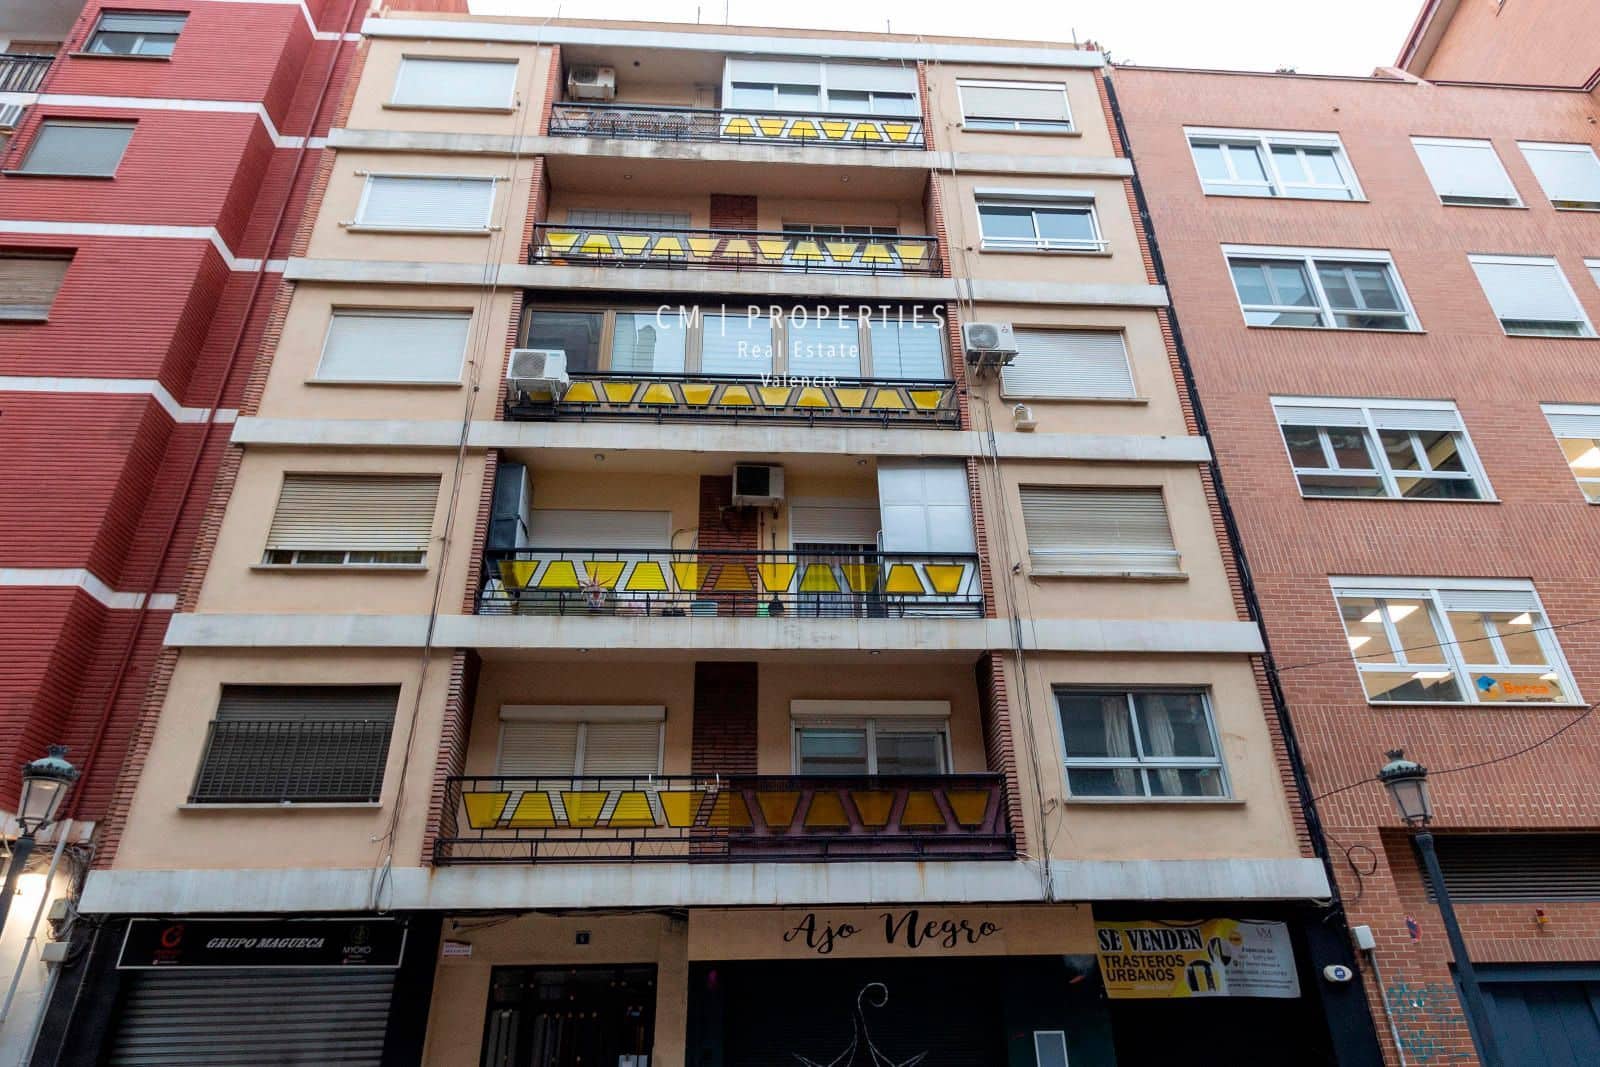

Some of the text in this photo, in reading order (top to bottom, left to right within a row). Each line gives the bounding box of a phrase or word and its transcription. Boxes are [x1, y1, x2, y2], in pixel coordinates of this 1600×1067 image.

[783, 910, 1002, 954] Ajo Negro
[1097, 928, 1203, 951] SE VENDEN
[206, 937, 257, 949] GRUPO
[1102, 954, 1186, 969] TRASTEROS
[1106, 967, 1176, 982] URBANOS
